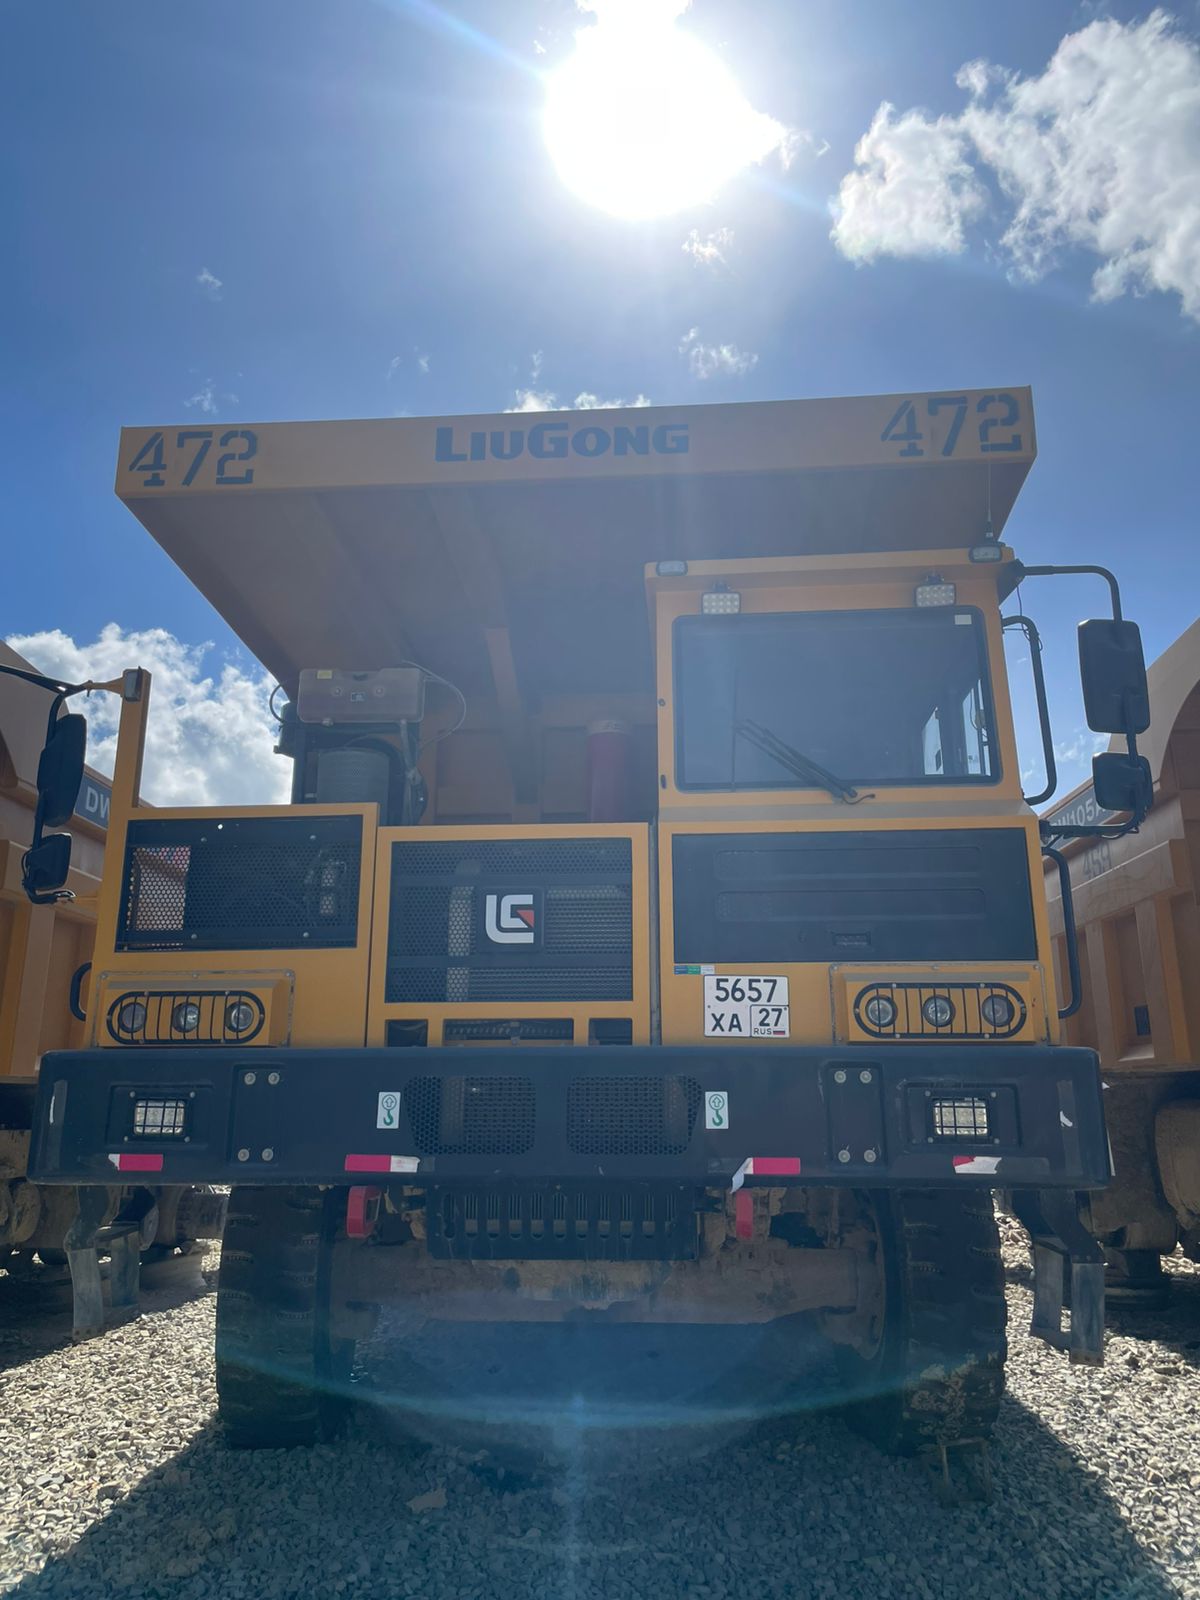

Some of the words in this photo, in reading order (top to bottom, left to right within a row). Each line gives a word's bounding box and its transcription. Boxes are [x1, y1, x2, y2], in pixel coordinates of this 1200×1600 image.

[881, 393, 1022, 456] 472
[128, 430, 257, 487] 472
[715, 978, 777, 1002] 5657
[758, 1008, 783, 1027] 27
